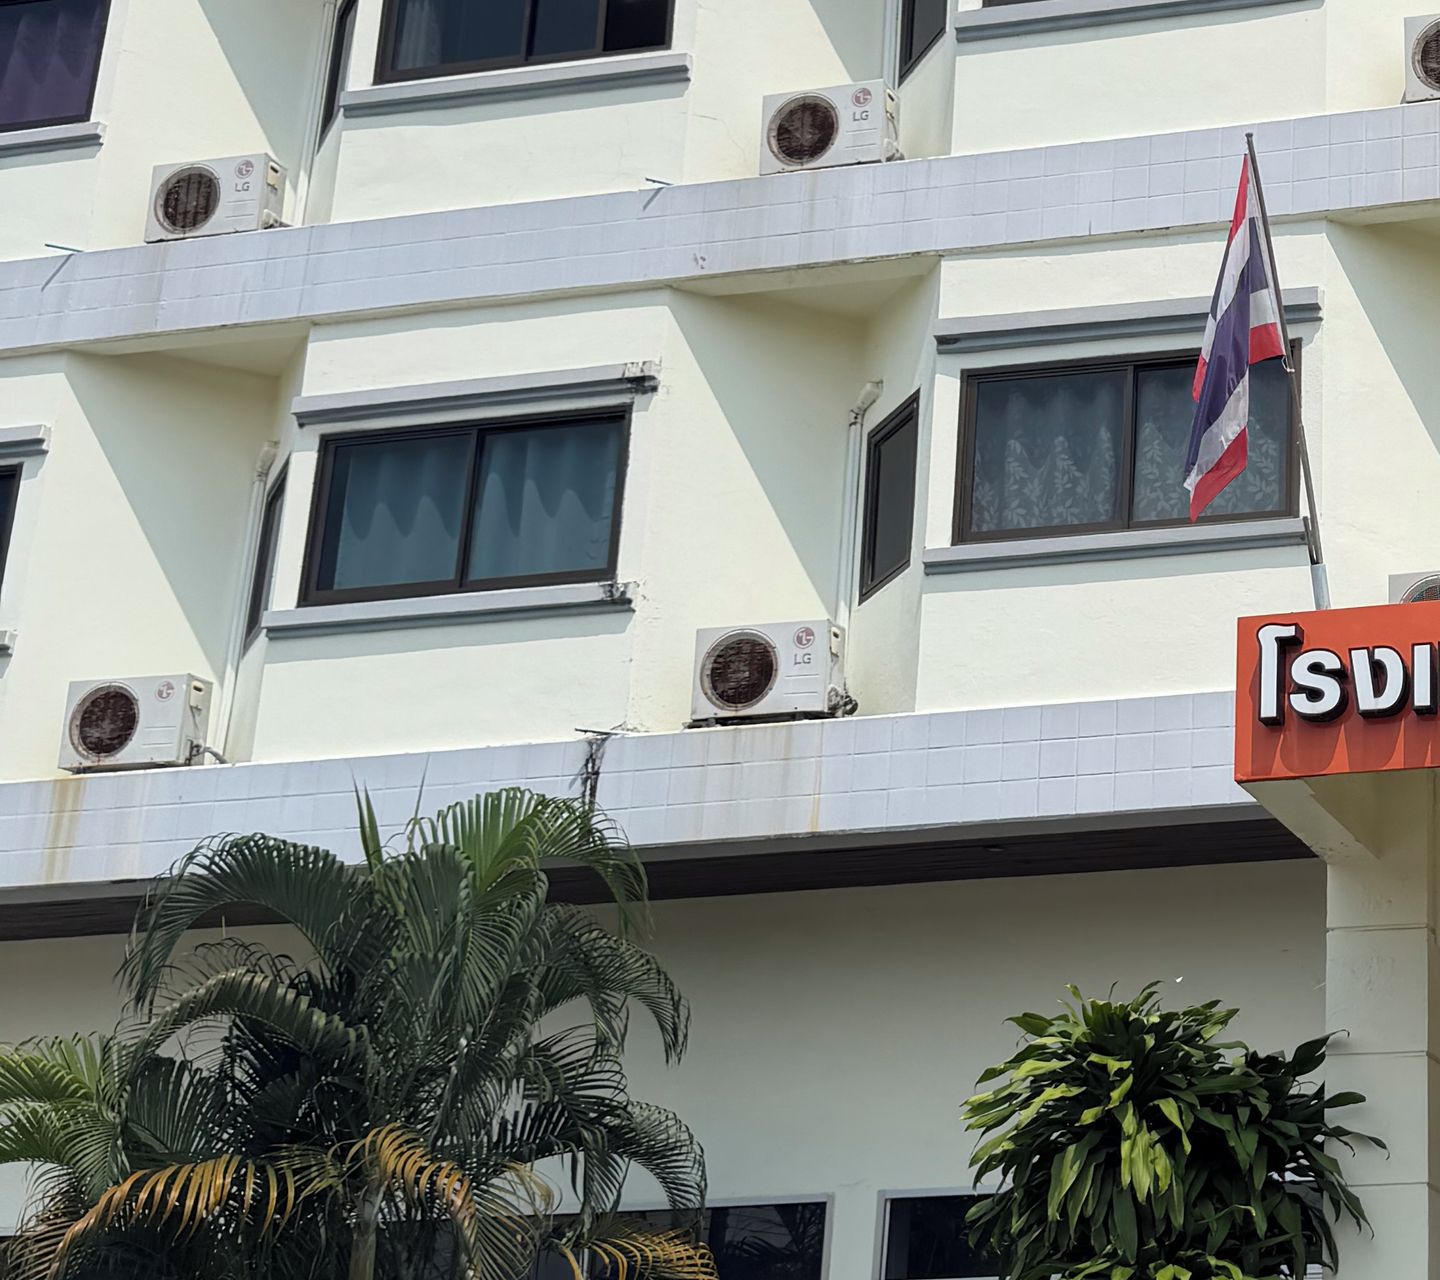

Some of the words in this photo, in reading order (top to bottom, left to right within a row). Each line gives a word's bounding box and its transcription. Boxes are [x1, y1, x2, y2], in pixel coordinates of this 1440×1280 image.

[852, 110, 870, 122] LG
[234, 181, 251, 193] LG
[793, 652, 812, 665] LG
